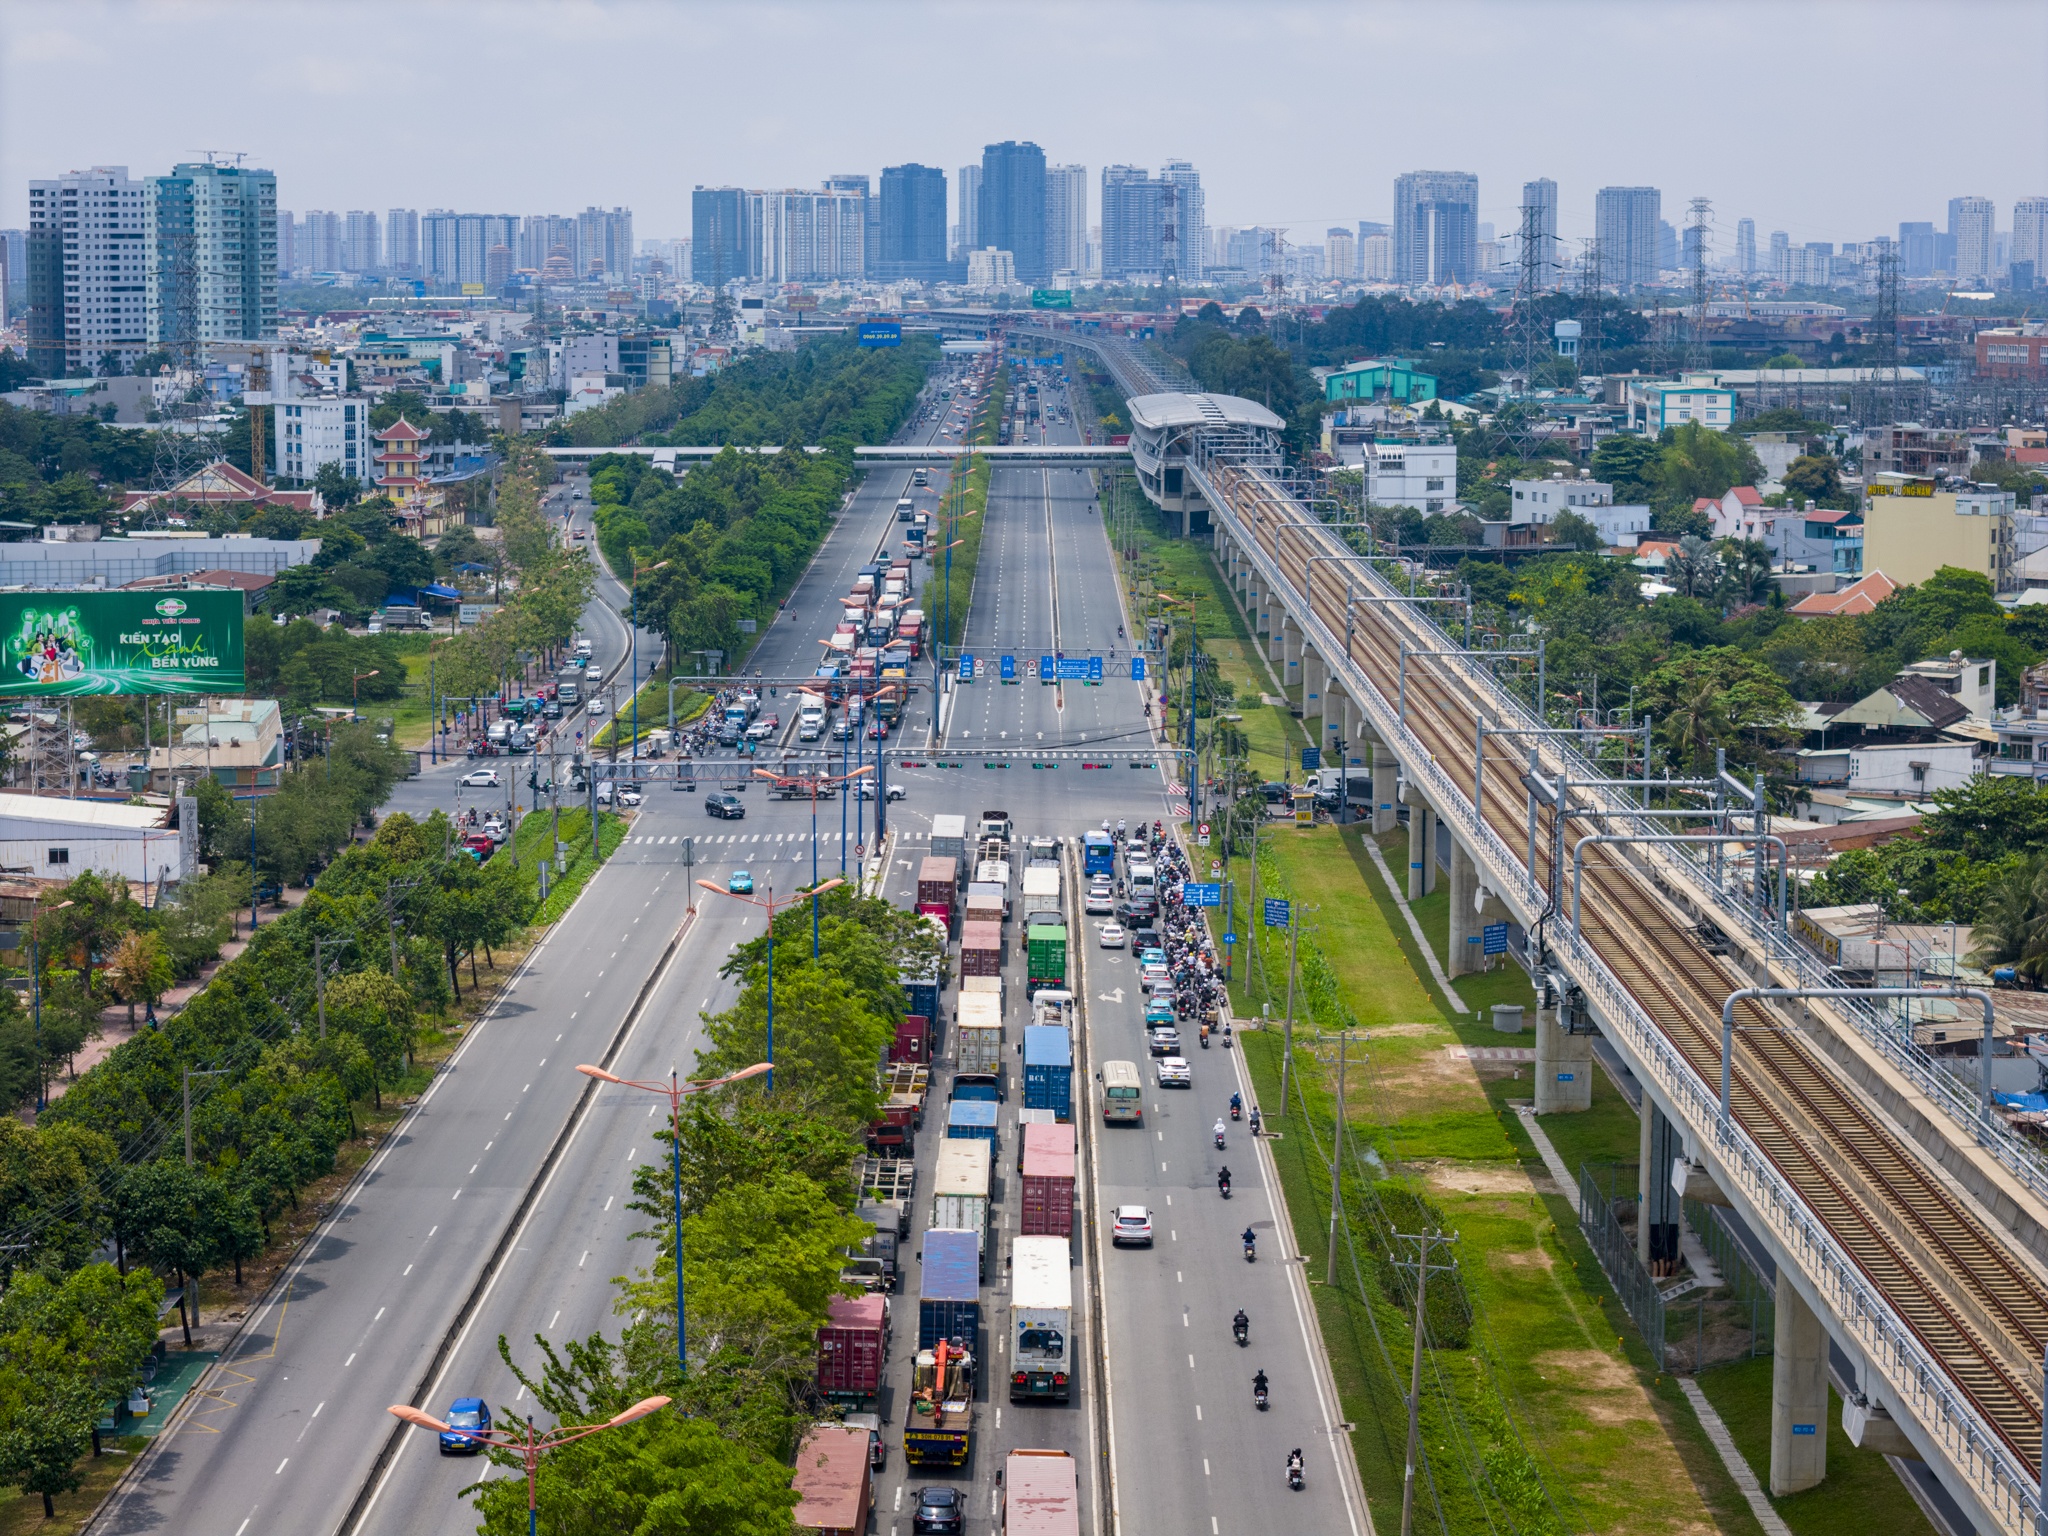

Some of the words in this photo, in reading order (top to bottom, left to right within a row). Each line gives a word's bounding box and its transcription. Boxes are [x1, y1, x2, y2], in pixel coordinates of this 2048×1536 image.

[1868, 485, 1888, 495] HOTEL
[1917, 485, 1931, 496] NAM
[120, 631, 149, 644] KIẾN
[153, 633, 179, 646] TẠO
[130, 630, 208, 667] Xanh
[182, 655, 219, 668] VỮNG
[1028, 1074, 1045, 1082] RCL
